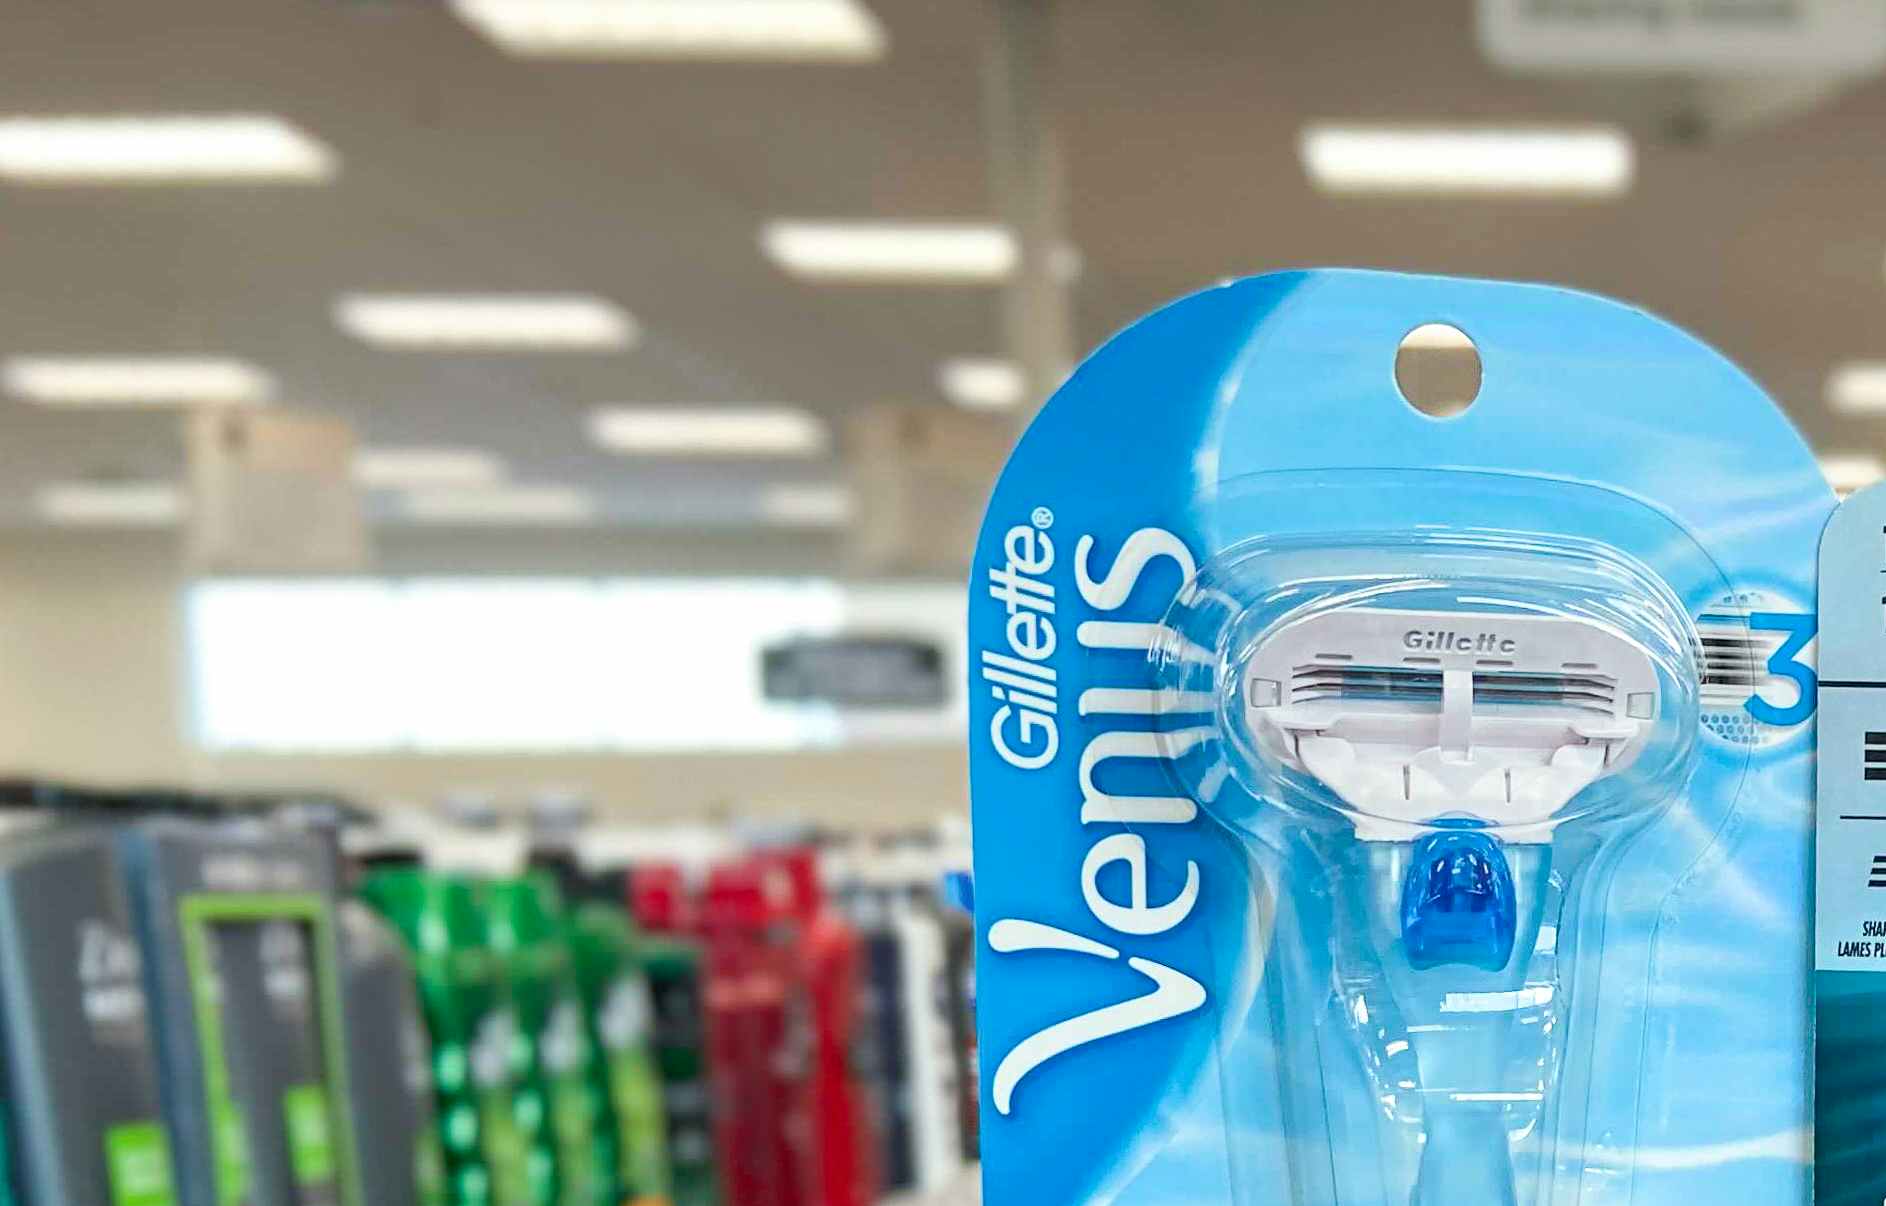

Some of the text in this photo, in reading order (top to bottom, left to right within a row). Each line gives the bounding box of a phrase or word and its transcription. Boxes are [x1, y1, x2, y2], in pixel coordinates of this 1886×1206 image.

[1402, 629, 1517, 654] Gillette
[1743, 612, 1818, 726] 3
[987, 527, 1212, 1115] Venus
[1837, 941, 1872, 958] LAMES
